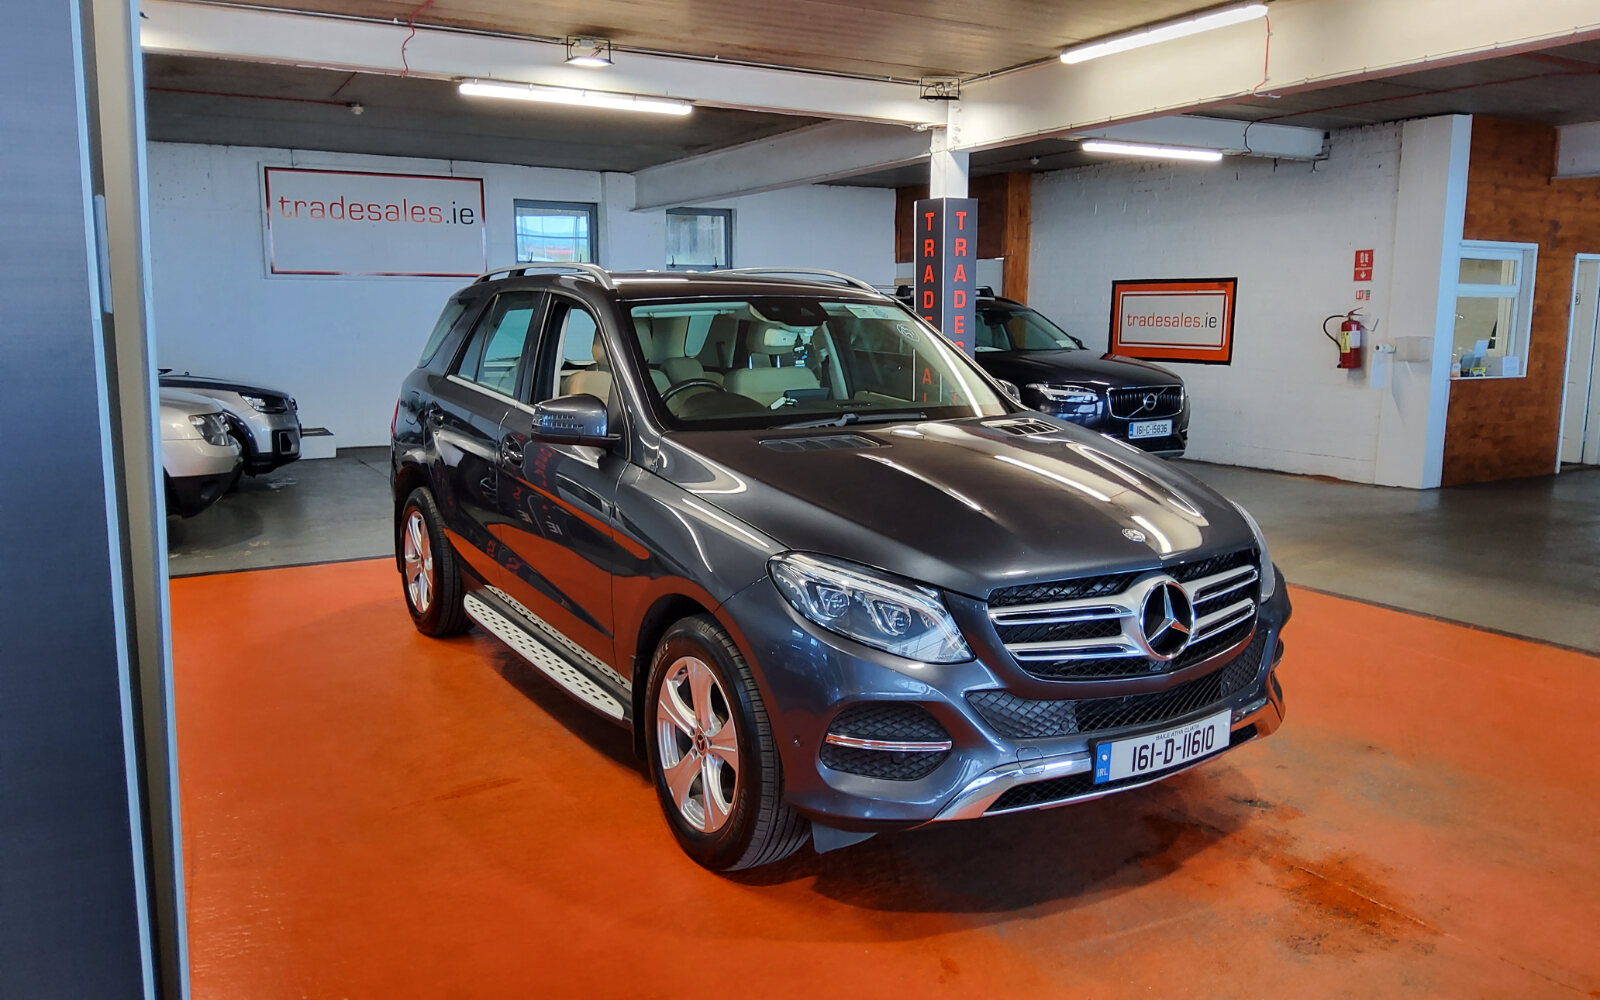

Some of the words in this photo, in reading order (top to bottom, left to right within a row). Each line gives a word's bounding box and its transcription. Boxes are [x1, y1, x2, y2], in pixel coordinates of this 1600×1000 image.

[278, 195, 474, 225] tradesales.ie
[1127, 311, 1218, 329] tradesales.ie
[1131, 724, 1215, 772] 161-D-11610
[1097, 768, 1108, 777] IRL
